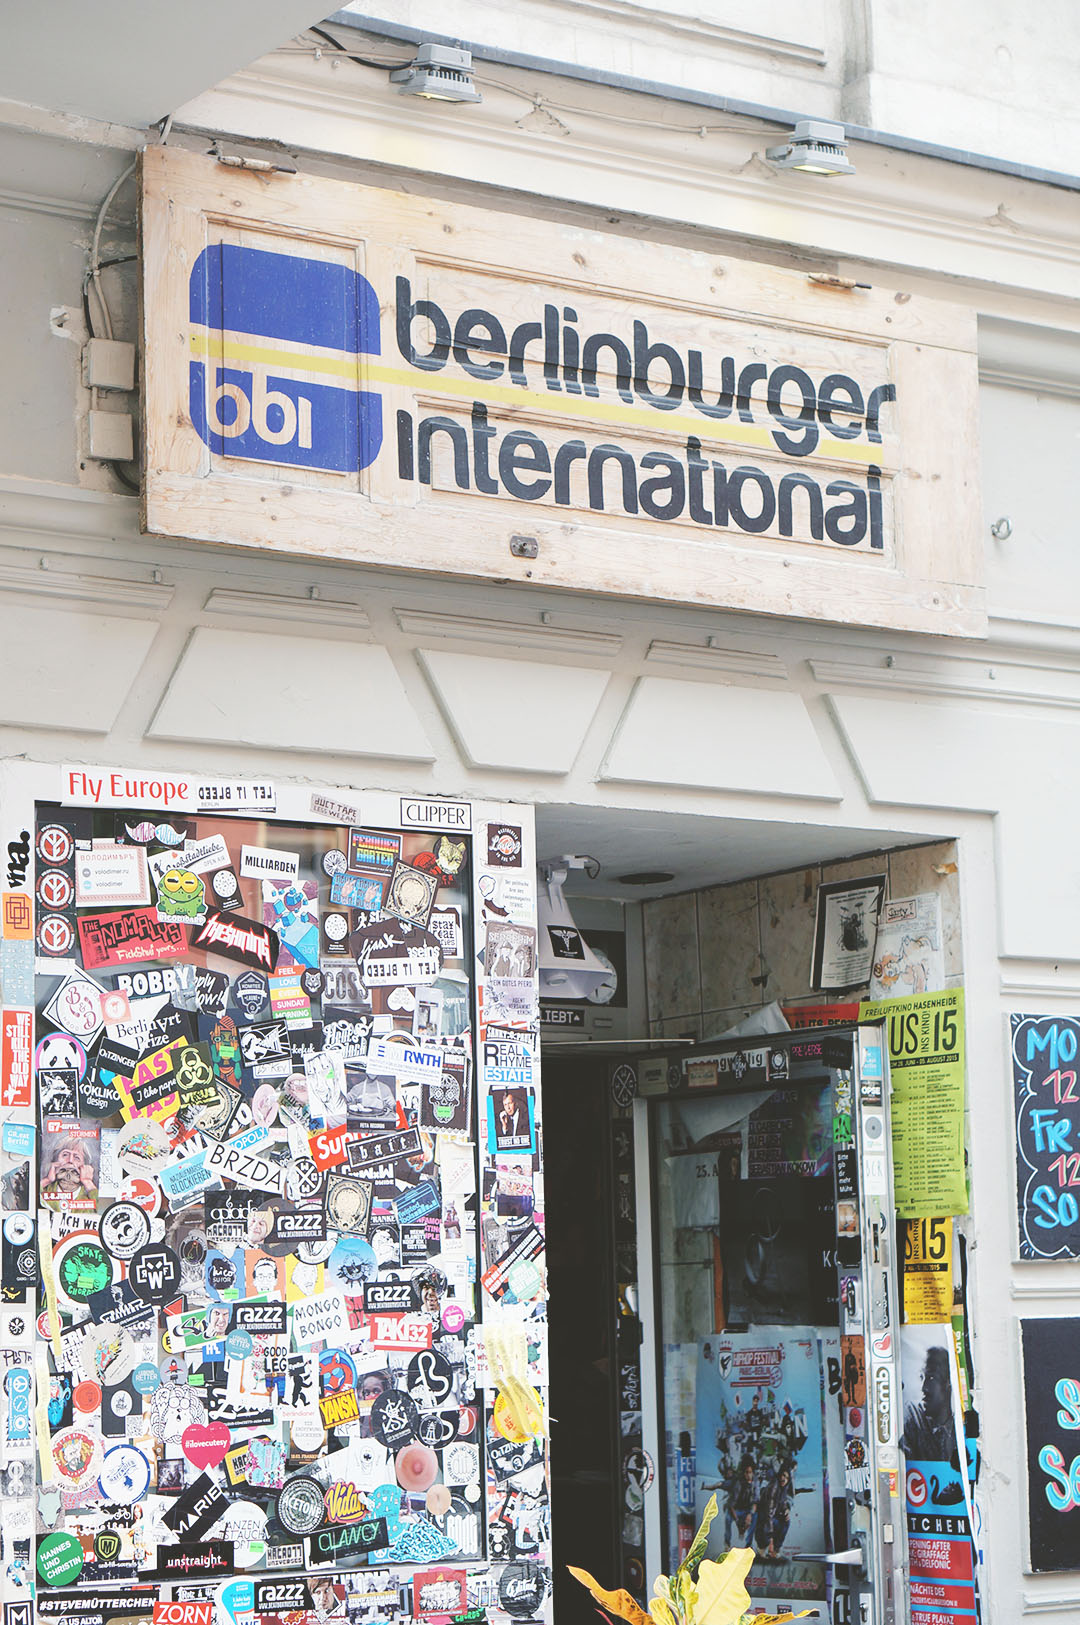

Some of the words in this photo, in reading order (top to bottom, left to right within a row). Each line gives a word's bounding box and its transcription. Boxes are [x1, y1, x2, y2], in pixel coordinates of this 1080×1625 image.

[395, 275, 897, 457] berlinburger
[395, 399, 885, 552] international
[68, 772, 103, 802] Fly
[109, 773, 189, 806] Europe
[406, 803, 466, 825] CLIPPER
[244, 855, 297, 874] MILLIARDEN
[84, 920, 99, 932] THE
[278, 967, 296, 976] FEEL
[117, 967, 190, 998] BOBBY
[279, 977, 298, 986] LOVE
[276, 999, 305, 1009] SUNDAY
[865, 1003, 913, 1017] FREILUFTKINO
[913, 996, 957, 1011] HASENHEIDE
[15, 1012, 31, 1027] WE
[275, 1009, 310, 1019] MORNING
[6, 1024, 30, 1038] STILL
[890, 1012, 919, 1056] US
[933, 1009, 957, 1052] 15
[11, 1037, 30, 1051] KILL
[135, 1032, 171, 1051] Prize
[920, 1036, 929, 1053] INS
[1026, 1024, 1078, 1070] MO
[12, 1049, 30, 1063] THE
[403, 1049, 441, 1068] RWTH
[927, 1055, 946, 1064] AUGUST
[11, 1061, 30, 1076] OLD
[486, 1068, 532, 1082] ESTATE
[9, 1073, 29, 1089] WAY
[1042, 1069, 1080, 1105] 12
[86, 1095, 109, 1109] design
[1029, 1108, 1074, 1153] FR
[209, 1143, 281, 1191] BRZDA
[1047, 1152, 1080, 1188] 12
[1032, 1185, 1078, 1230] SO
[276, 1214, 323, 1231] razzz
[922, 1218, 946, 1260] 15
[77, 1245, 103, 1262] SKATE
[367, 1285, 411, 1302] razzz
[236, 1306, 283, 1323] razzz
[295, 1297, 341, 1321] MONGO
[299, 1314, 343, 1339] BONGO
[263, 1346, 287, 1357] GOOD
[754, 1350, 780, 1365] FESTIVAL
[264, 1357, 287, 1373] LEG
[184, 1439, 228, 1449] #ilovecutesy
[172, 1484, 222, 1541] MARIE
[318, 1521, 380, 1552] CLANCY
[39, 1540, 72, 1561] HANNES
[932, 1541, 951, 1551] AFTER
[43, 1556, 60, 1571] UND
[46, 1555, 82, 1579] CHRISTIN
[166, 1553, 223, 1569] unstraight
[922, 1559, 951, 1570] DELFONIC
[258, 1583, 305, 1602] razzz
[934, 1586, 945, 1597] DES
[39, 1597, 157, 1611] #STEVEMÜTTERCHEN
[155, 1603, 211, 1625] ZORN
